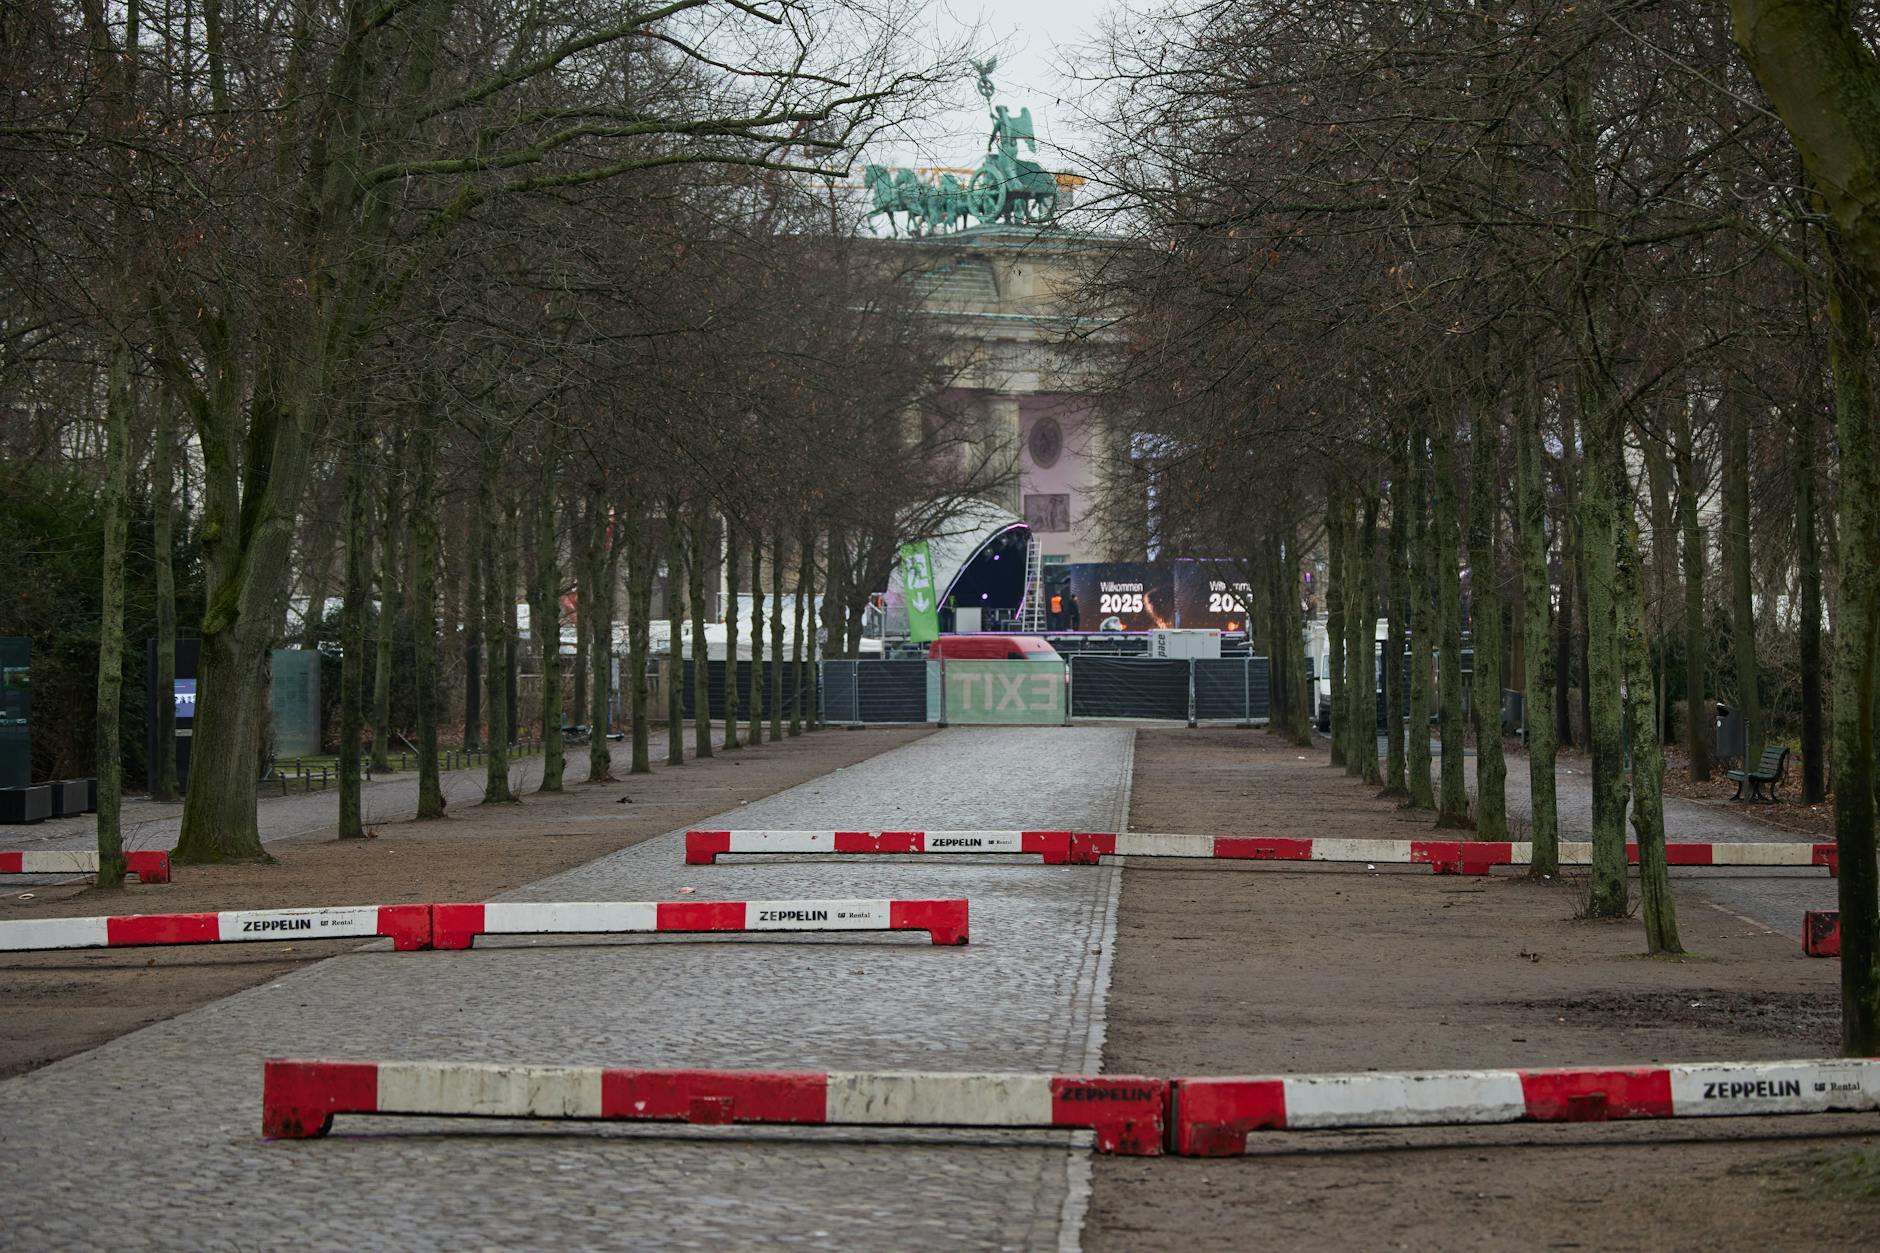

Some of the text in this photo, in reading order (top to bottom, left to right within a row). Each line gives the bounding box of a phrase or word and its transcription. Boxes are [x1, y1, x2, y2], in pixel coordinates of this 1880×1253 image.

[1100, 581, 1143, 592] Willkommen
[1100, 593, 1144, 613] 2025
[932, 838, 982, 847] ZEPPELIN
[759, 910, 828, 921] ZEPPELIN
[243, 919, 311, 932] ZEPPELIN
[1061, 1086, 1153, 1103] ZEPPELIN
[1703, 1080, 1801, 1099] ZEPPELIN
[1830, 1081, 1860, 1092] Rental
